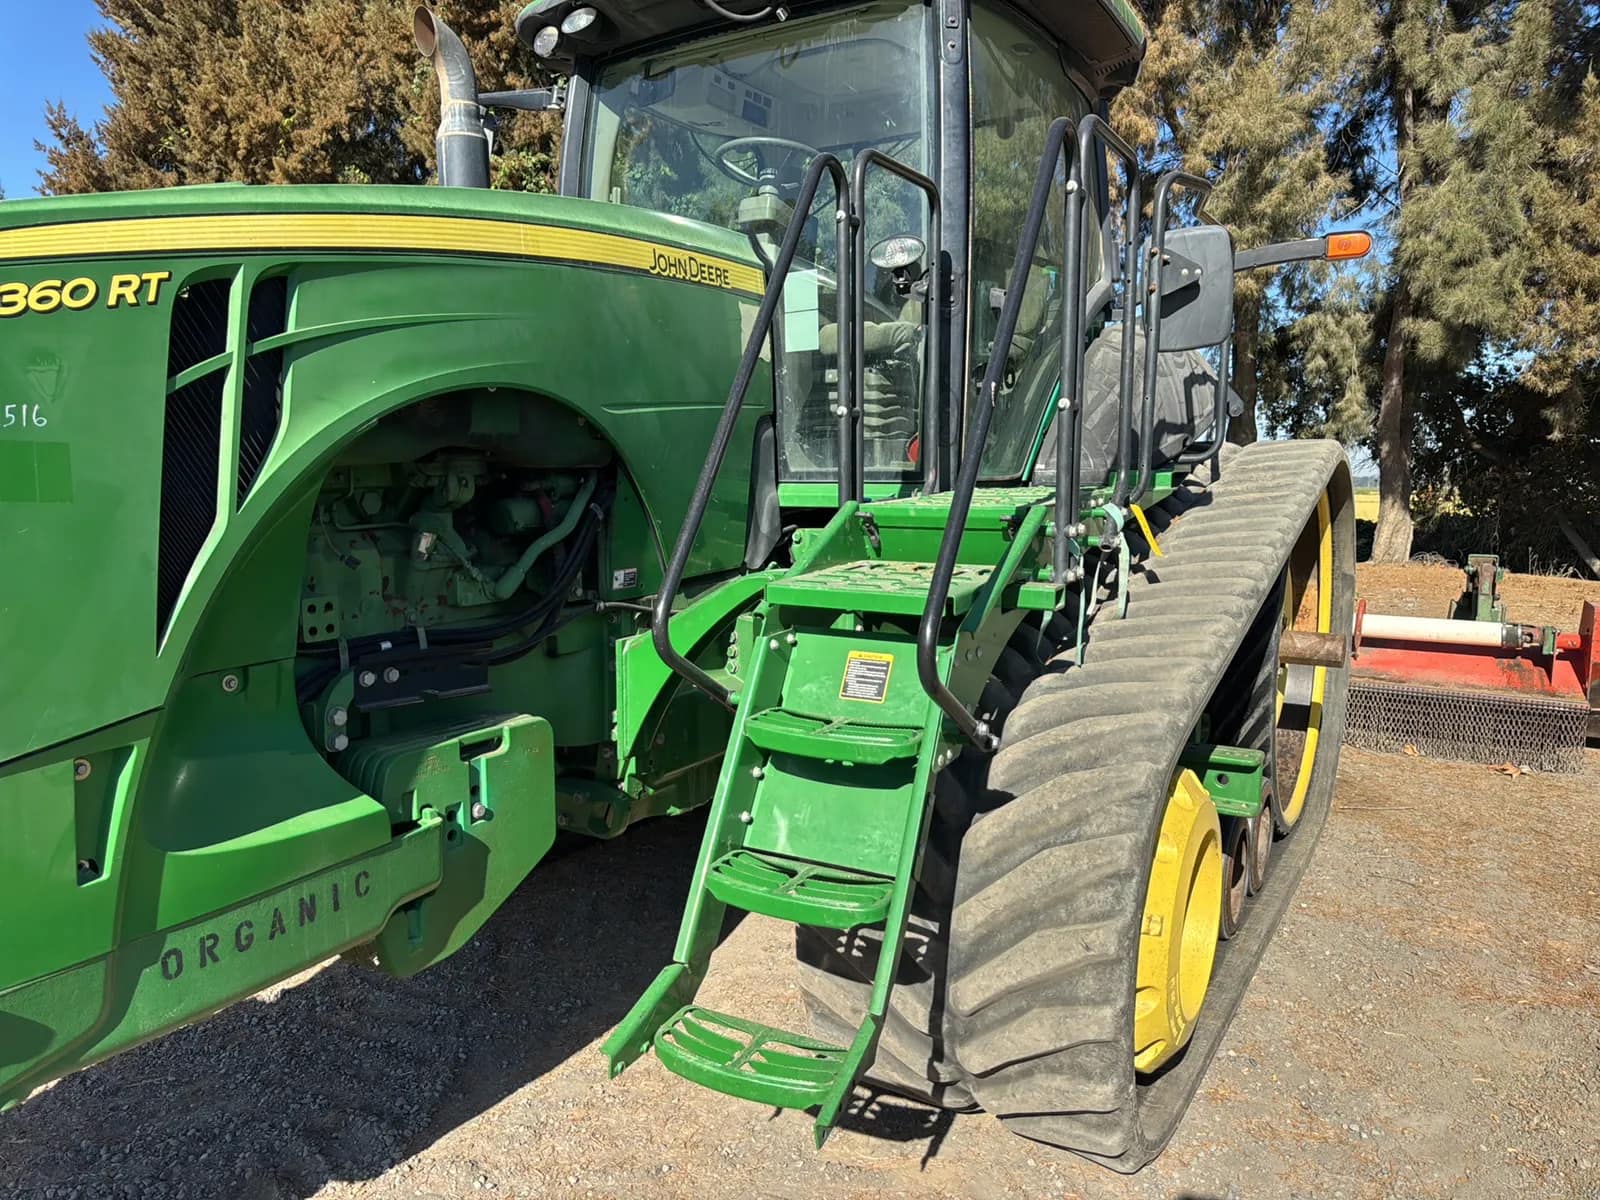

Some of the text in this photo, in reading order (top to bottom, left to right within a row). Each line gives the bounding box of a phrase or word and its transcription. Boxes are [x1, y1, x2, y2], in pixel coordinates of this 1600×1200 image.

[0, 271, 171, 317] 360 RT
[3, 403, 48, 428] 516
[161, 870, 370, 980] ORGANIC
